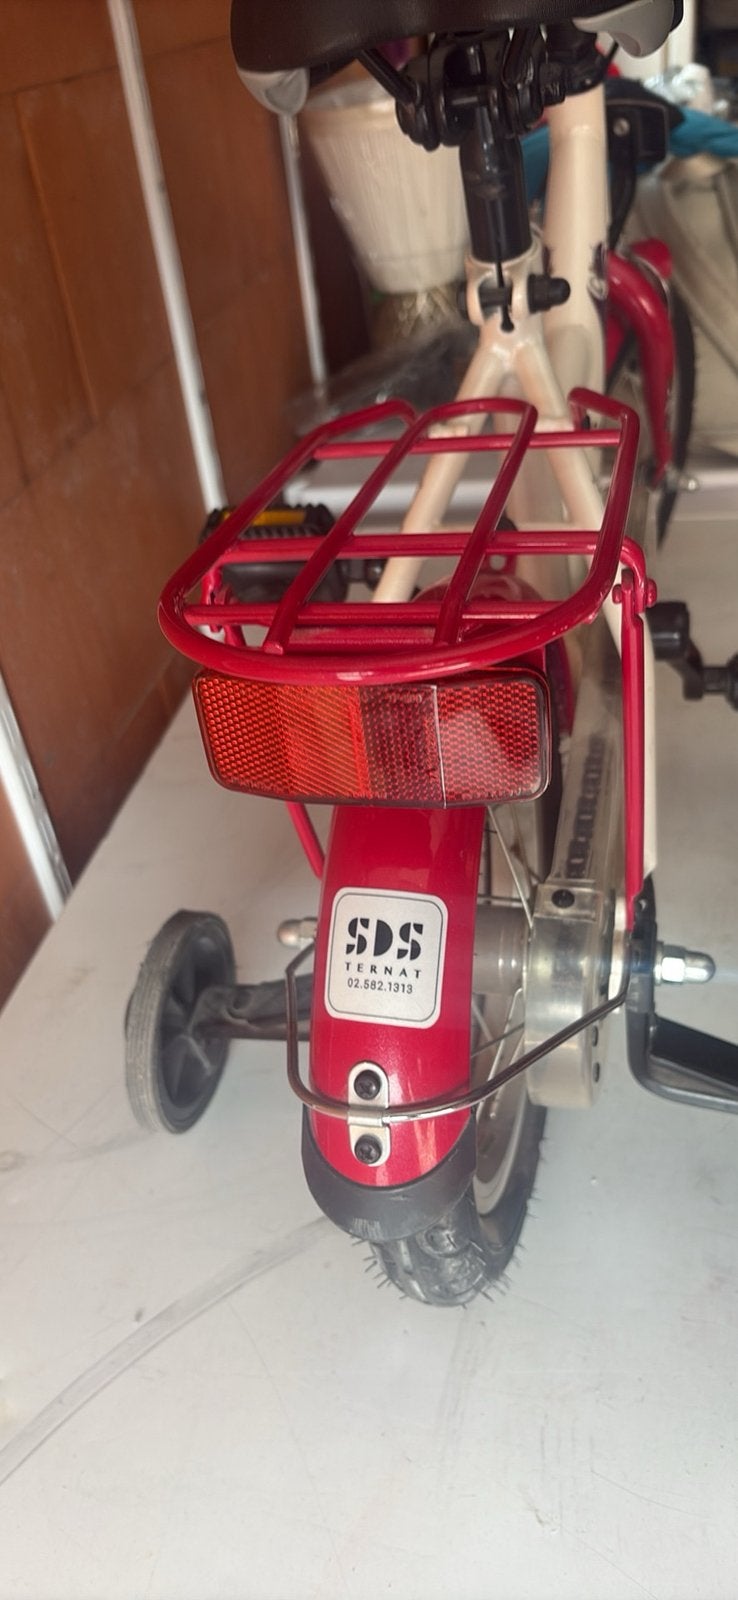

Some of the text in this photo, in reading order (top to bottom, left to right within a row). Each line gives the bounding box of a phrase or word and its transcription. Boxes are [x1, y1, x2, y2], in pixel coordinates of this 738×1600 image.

[346, 917, 424, 961] SDS
[345, 962, 421, 979] TERNAT
[347, 978, 413, 994] 02.582.1313
